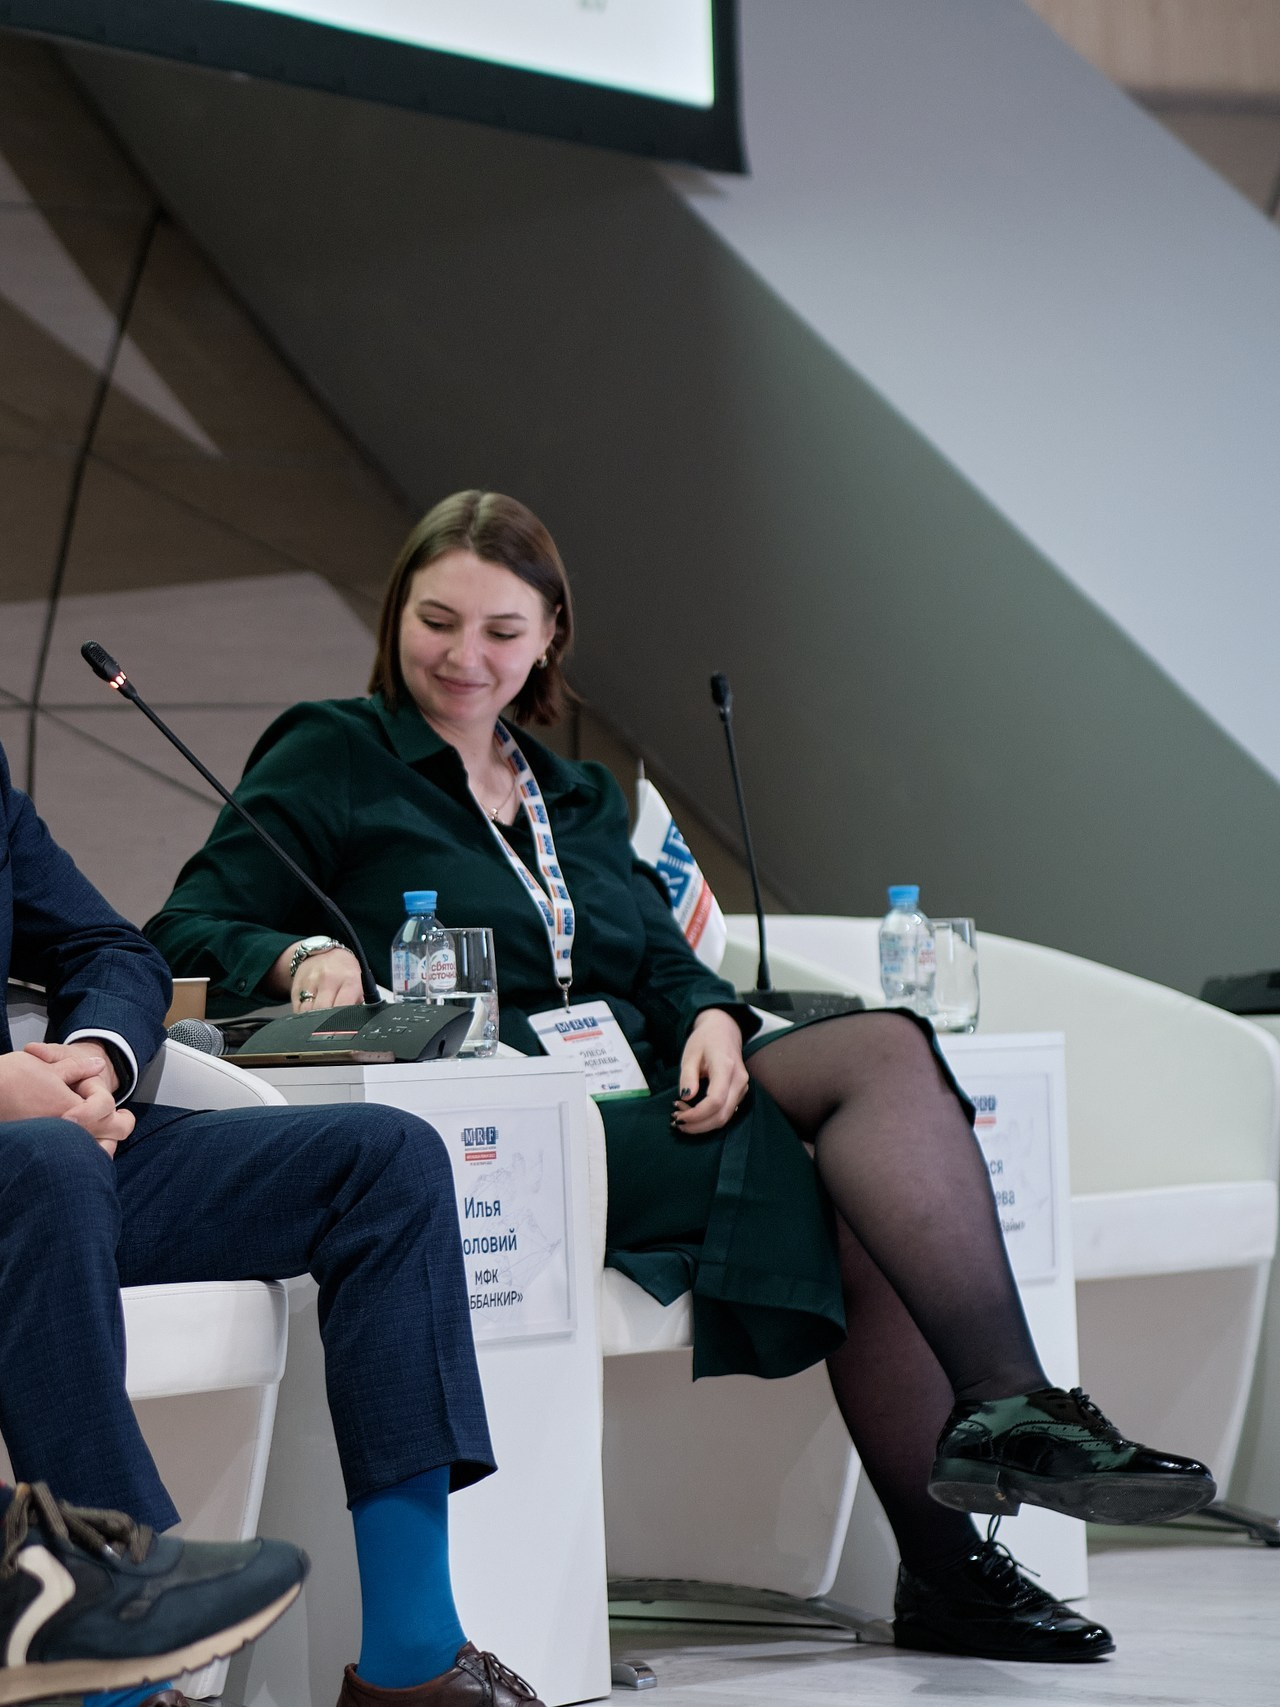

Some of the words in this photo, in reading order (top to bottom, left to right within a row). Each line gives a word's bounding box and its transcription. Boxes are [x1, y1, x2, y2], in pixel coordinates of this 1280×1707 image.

[464, 1126, 496, 1146] MRF
[464, 1196, 502, 1219] Илья
[463, 1227, 518, 1255] оловий
[475, 1268, 499, 1286] МФК
[470, 1290, 524, 1310] ББАНКИР»
